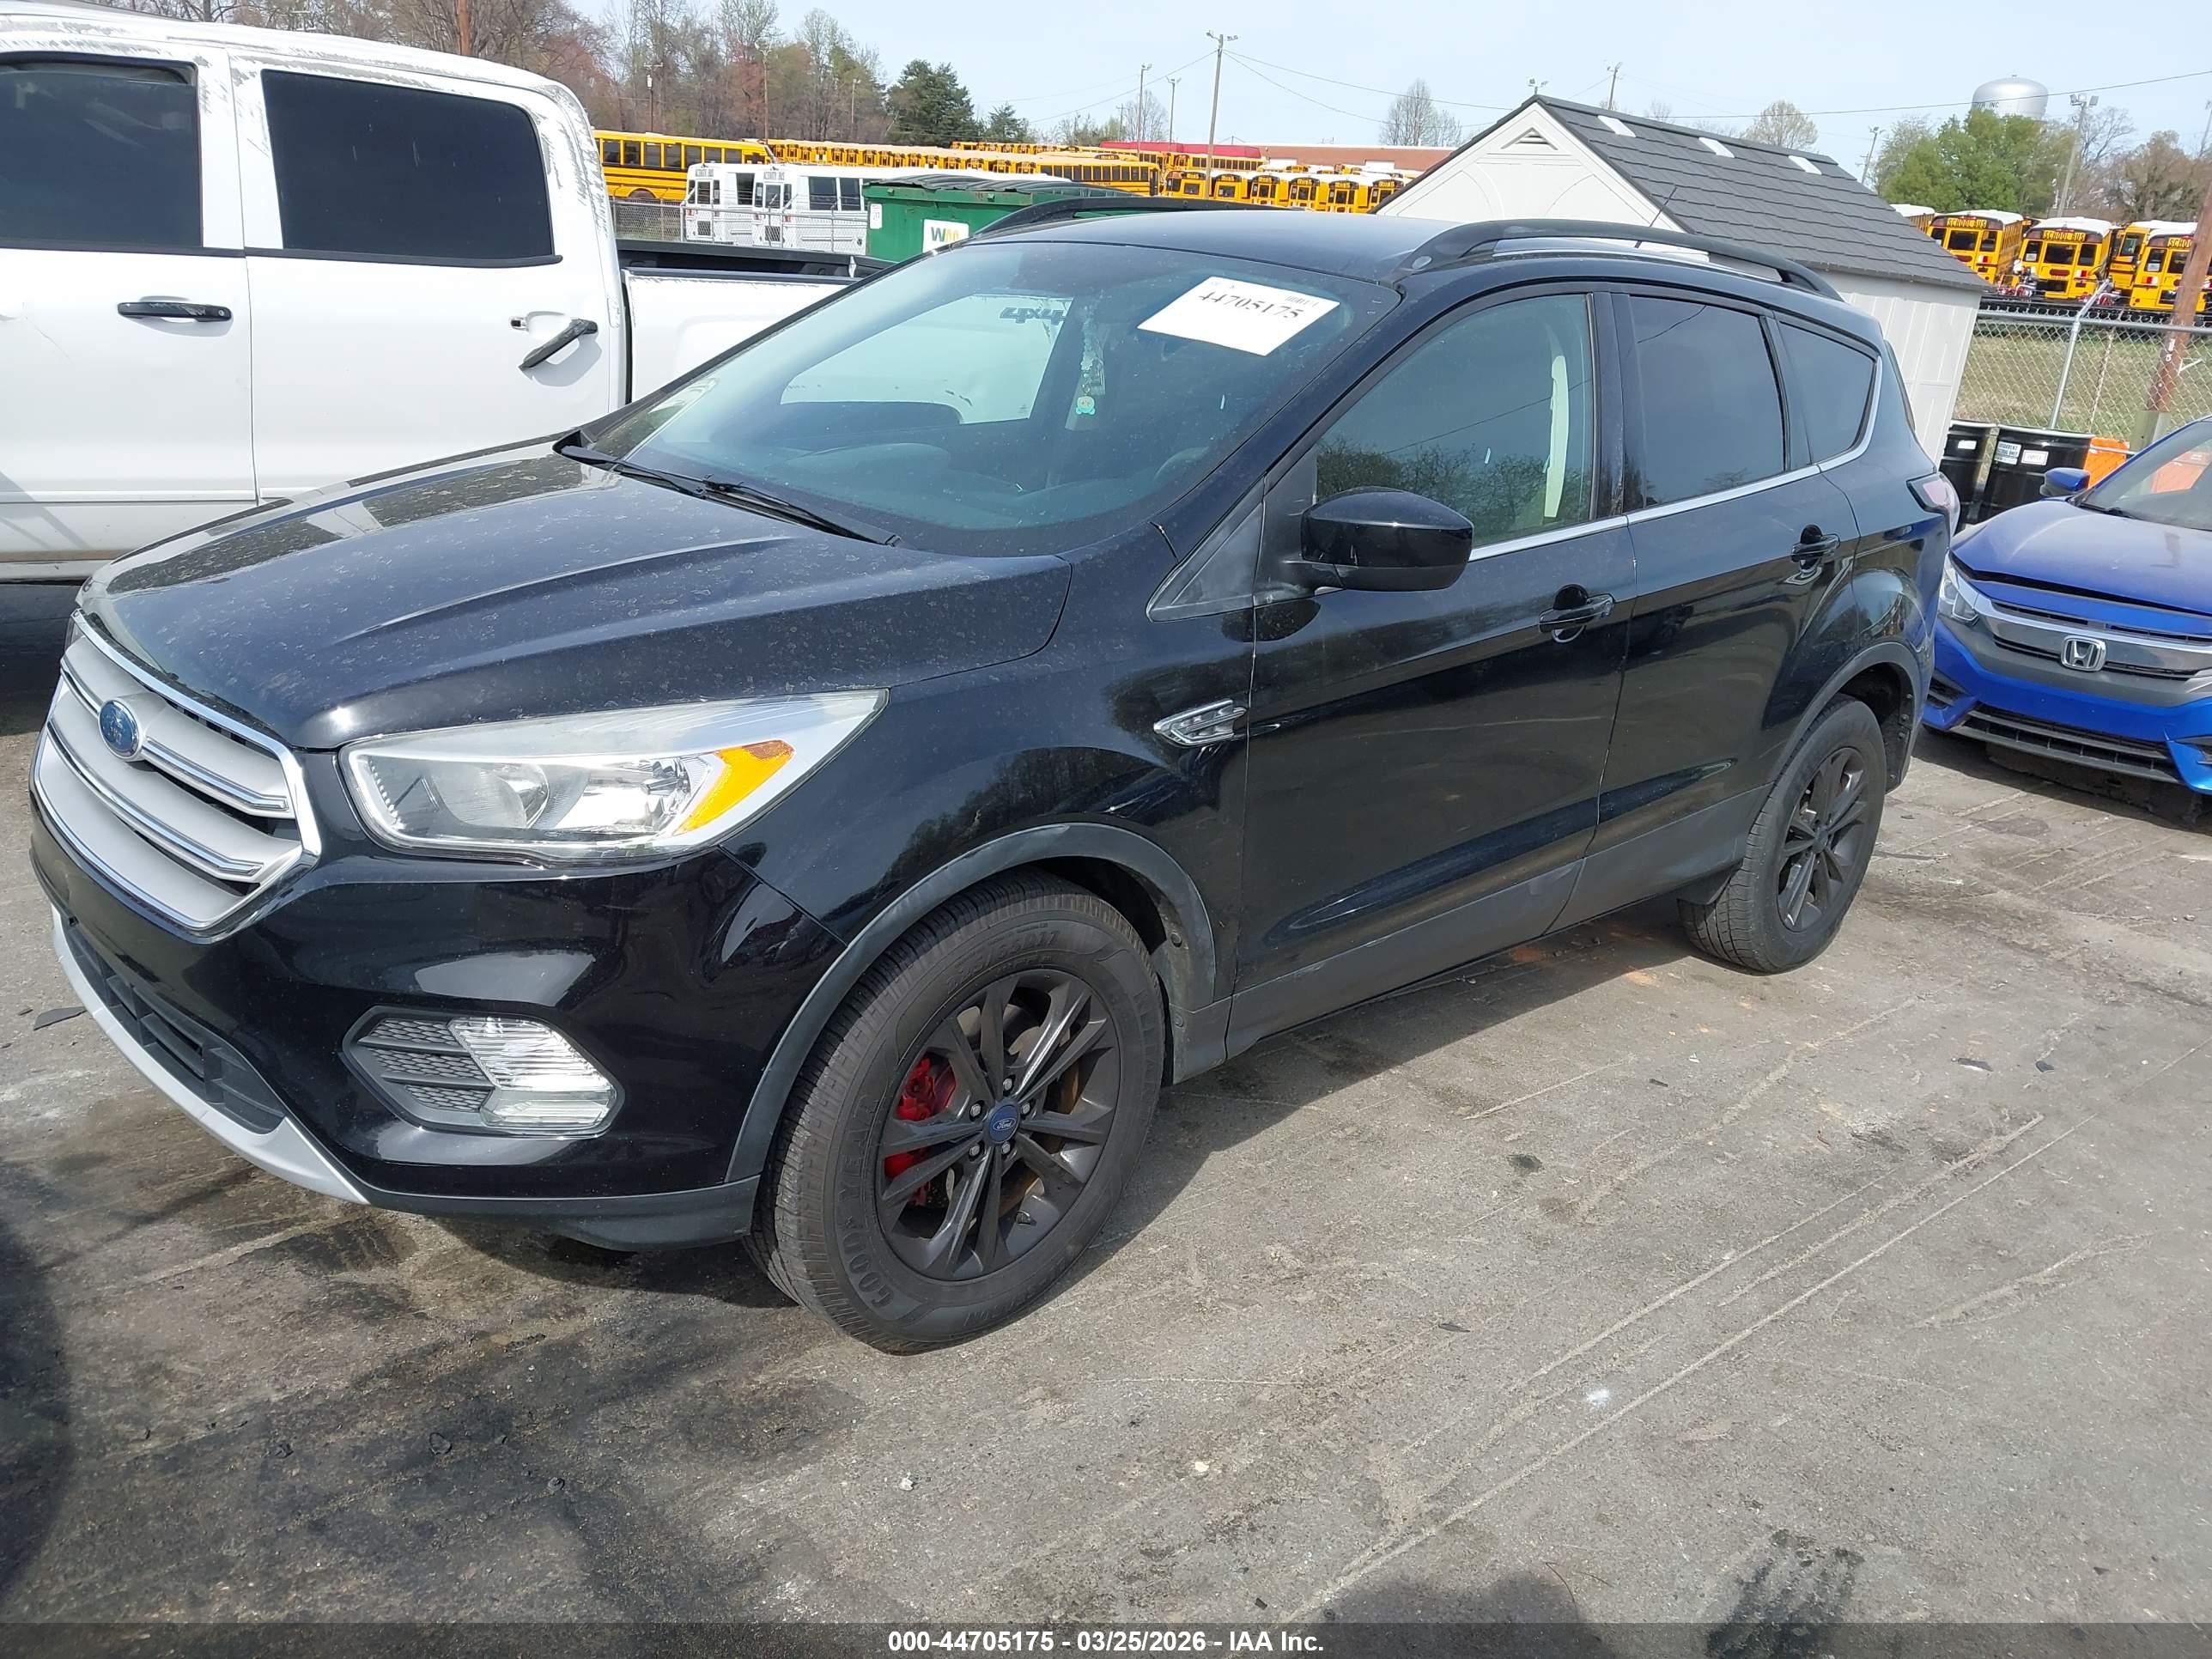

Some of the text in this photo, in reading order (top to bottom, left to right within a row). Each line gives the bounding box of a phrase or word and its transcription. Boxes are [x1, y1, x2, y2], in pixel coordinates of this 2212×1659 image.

[1948, 218, 1972, 228] SCHOOL
[2045, 231, 2085, 241] SCHOOL BUS
[1197, 291, 1305, 319] 44705175
